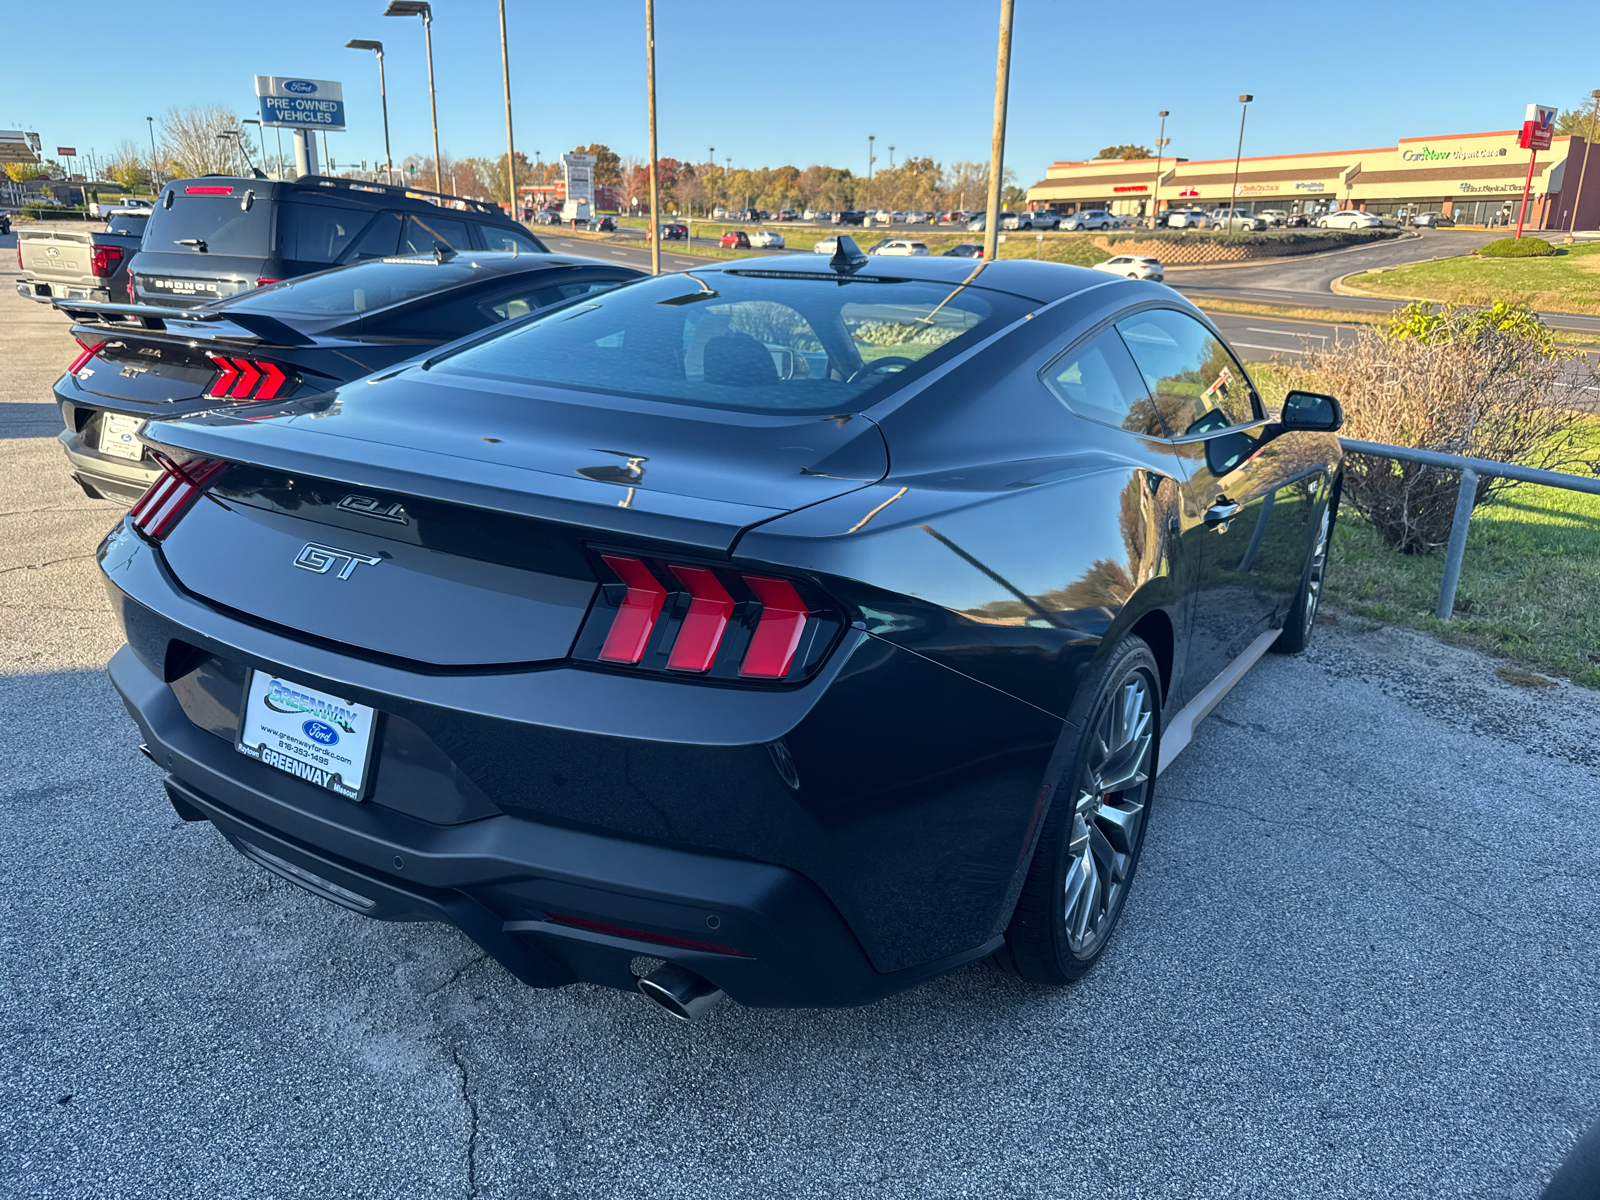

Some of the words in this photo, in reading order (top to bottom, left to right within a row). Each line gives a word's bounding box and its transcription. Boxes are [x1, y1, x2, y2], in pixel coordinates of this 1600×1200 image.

[290, 82, 312, 92] Ford
[276, 110, 332, 123] VEHICLES
[155, 280, 217, 292] BRONCO
[119, 365, 149, 379] GT
[293, 541, 384, 581] GT
[267, 679, 358, 729] GREENWAY
[308, 722, 333, 743] Ford
[260, 724, 352, 766] www.greenwayfordkc.com
[278, 740, 330, 766] 816-353-1495
[262, 748, 333, 788] GREENWAY
[333, 782, 358, 800] Missouri
